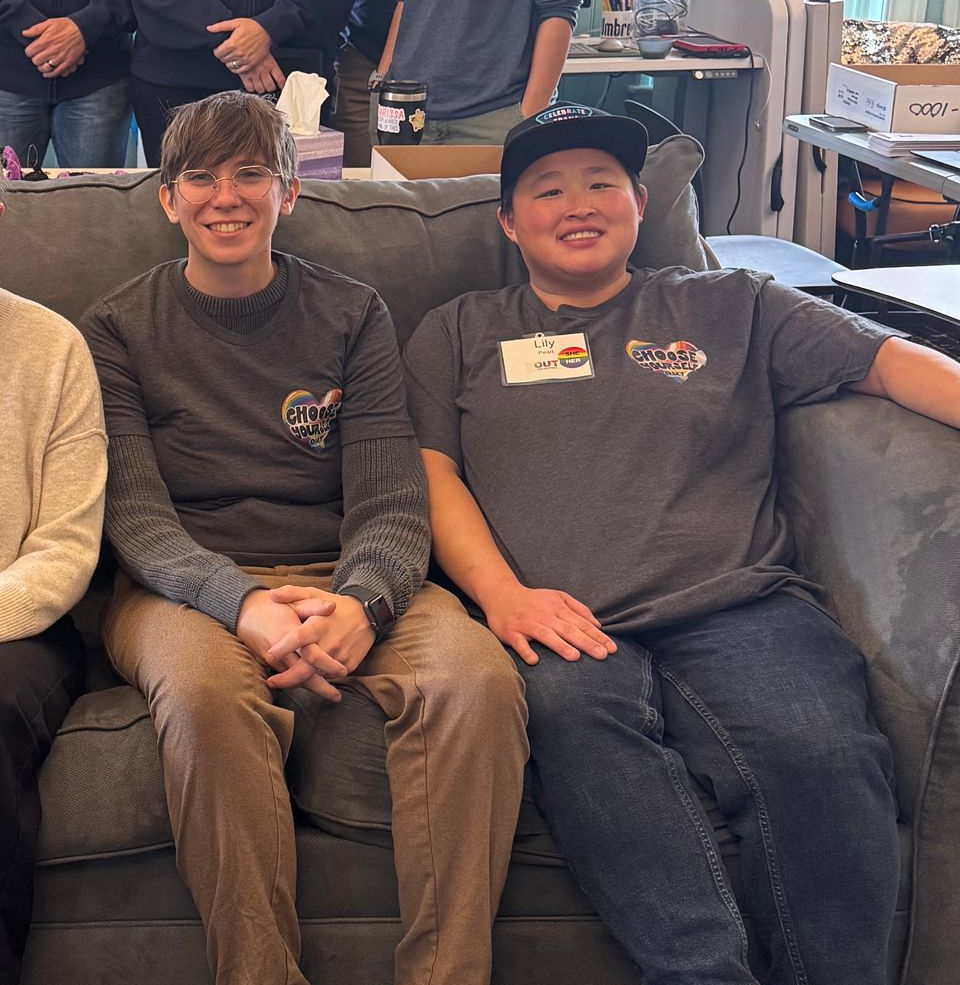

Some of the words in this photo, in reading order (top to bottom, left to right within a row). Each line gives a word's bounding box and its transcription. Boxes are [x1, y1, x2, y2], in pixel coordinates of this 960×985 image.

[543, 108, 586, 120] CELEBRATE
[534, 339, 555, 349] Lily
[632, 349, 698, 363] CHOOSE
[534, 360, 558, 369] OUT
[640, 362, 698, 371] YOURSELF
